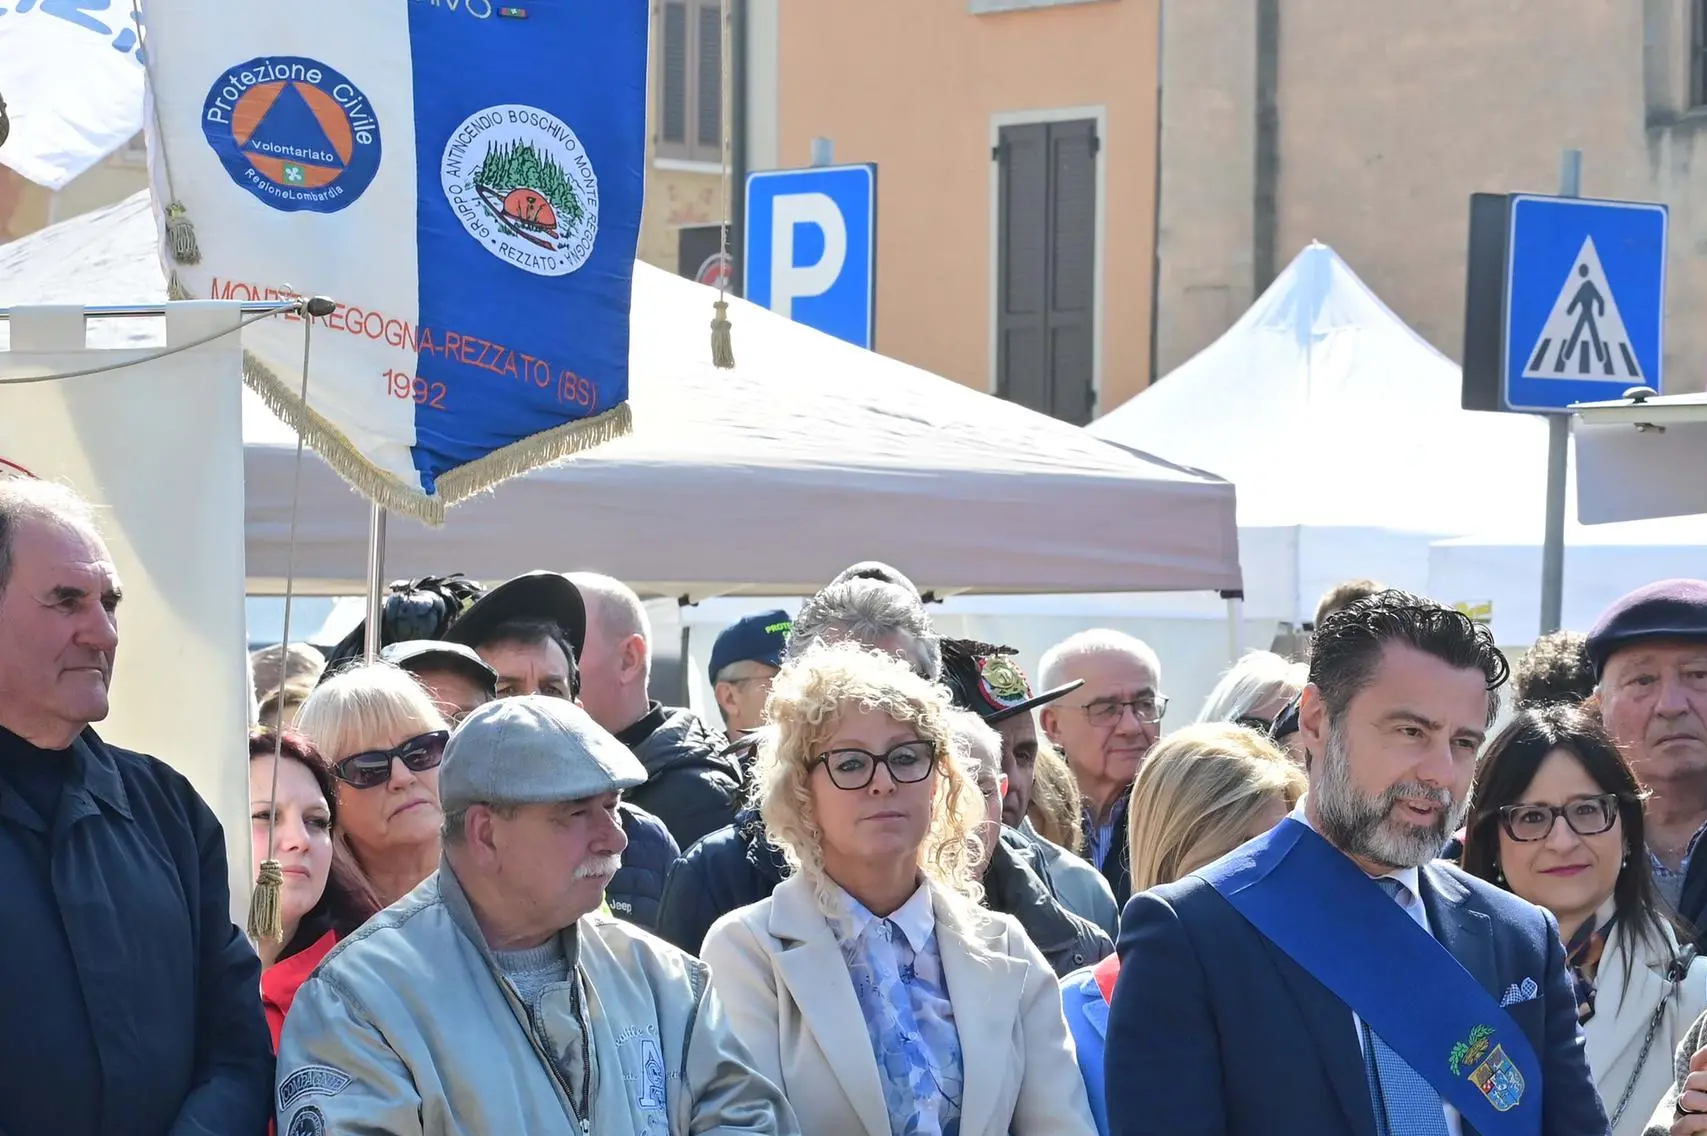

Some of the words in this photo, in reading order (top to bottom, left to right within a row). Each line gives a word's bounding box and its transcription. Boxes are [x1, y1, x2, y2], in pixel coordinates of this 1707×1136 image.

[207, 60, 322, 124] Protezione
[333, 83, 376, 145] Civile
[252, 140, 334, 162] Volontariato
[446, 111, 503, 178] ANTINCENDIO
[508, 110, 576, 151] BOSCHIVO
[574, 155, 597, 207] MONTE
[449, 184, 490, 238] GRUPPO
[499, 242, 557, 270] REZZATO
[565, 212, 597, 266] REGOGNA
[770, 192, 847, 320] P
[382, 368, 447, 409] 1992
[557, 370, 598, 416] (BS)
[610, 898, 632, 914] Jeep
[283, 1071, 344, 1100] COMPAGNIE
